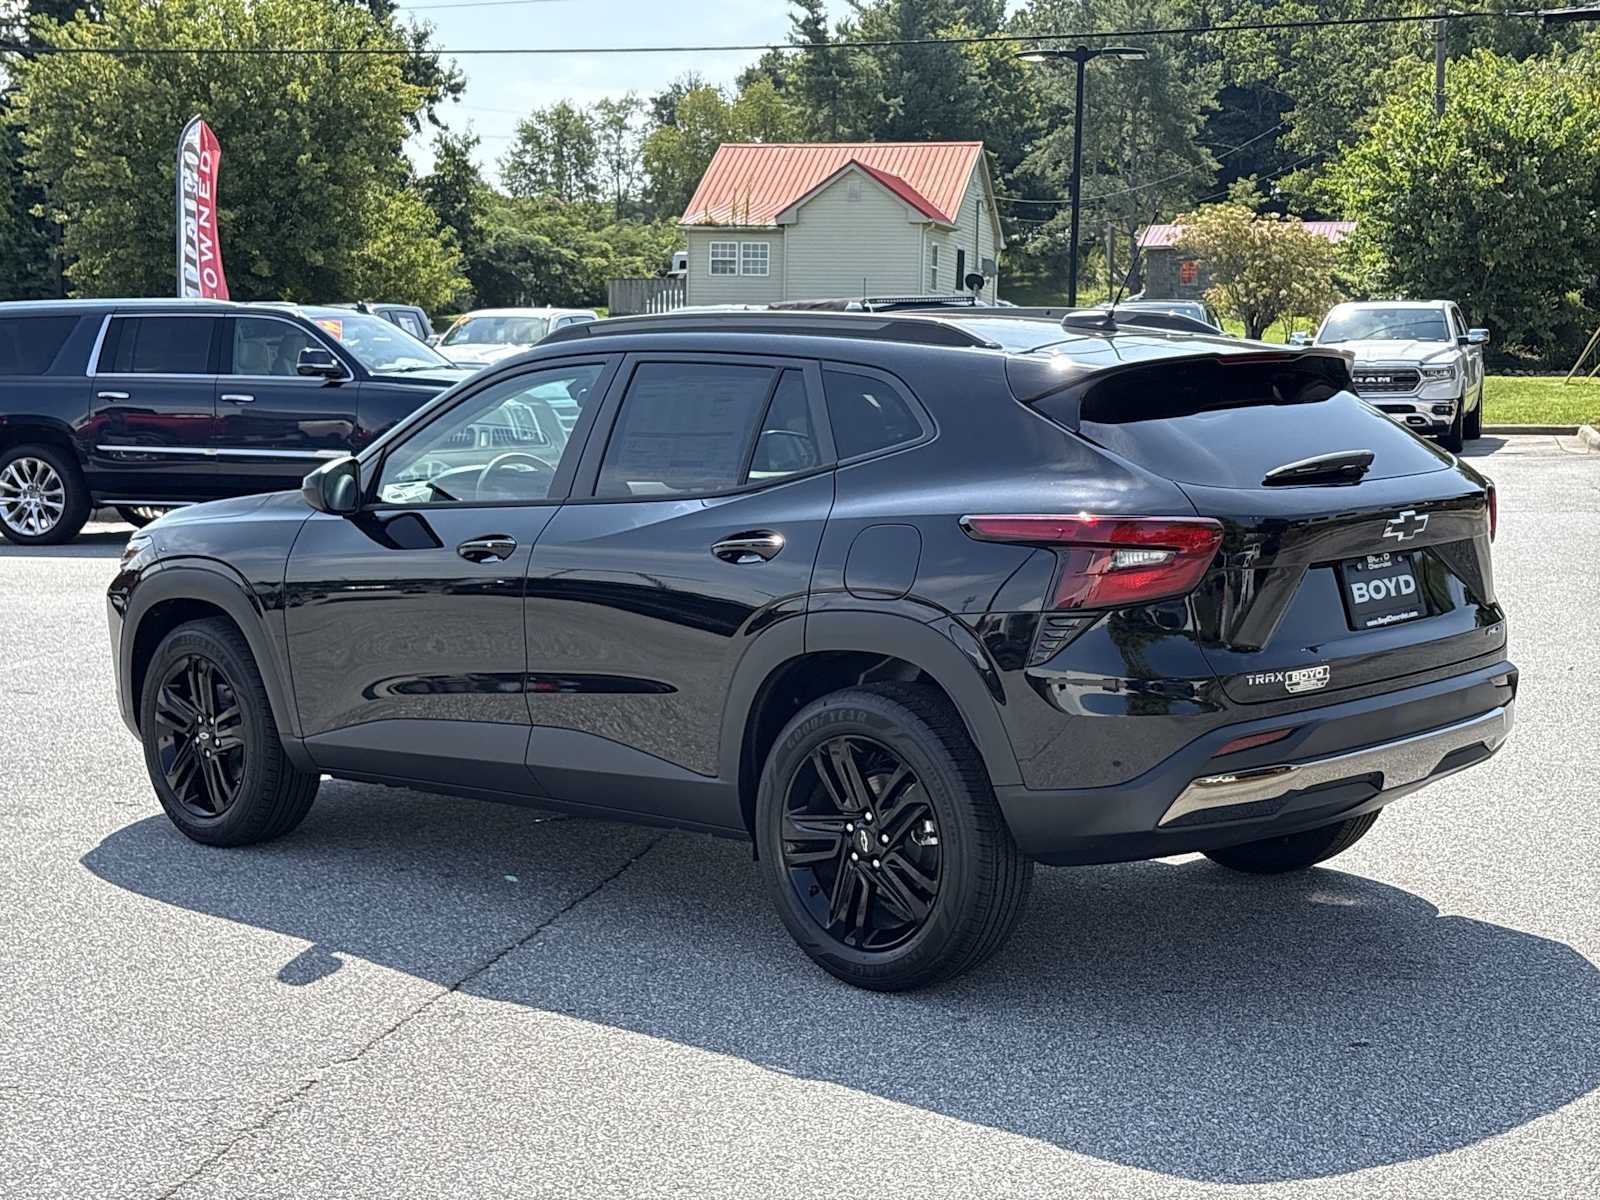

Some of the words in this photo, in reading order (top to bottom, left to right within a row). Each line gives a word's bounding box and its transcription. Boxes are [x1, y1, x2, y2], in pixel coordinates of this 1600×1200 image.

[1350, 574, 1416, 604] BOYD
[1245, 671, 1285, 686] TRAX
[1291, 668, 1325, 682] BOYD
